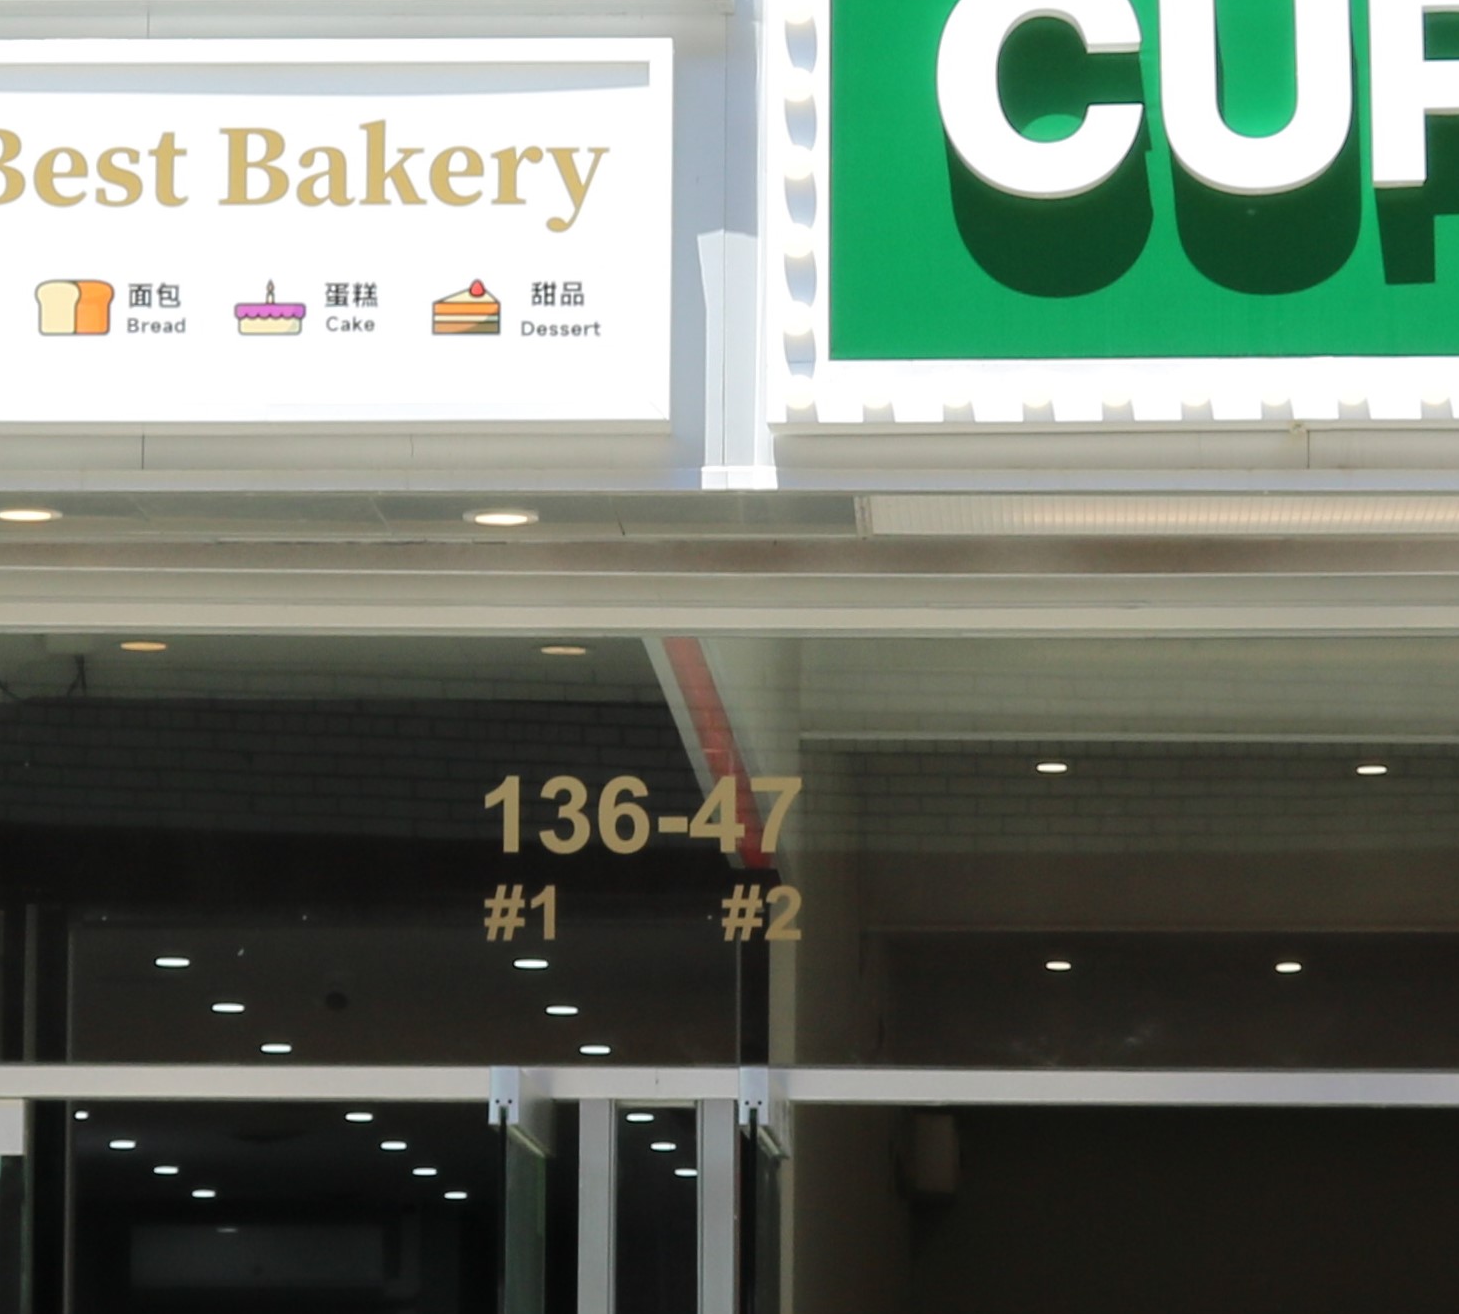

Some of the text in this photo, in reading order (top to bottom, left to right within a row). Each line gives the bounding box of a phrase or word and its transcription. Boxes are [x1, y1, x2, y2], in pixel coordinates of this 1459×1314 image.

[217, 119, 610, 233] Bakery
[127, 281, 181, 309] 面包
[324, 281, 379, 309] 蛋糕
[530, 280, 585, 309] 甜品
[126, 316, 187, 335] Bread
[325, 314, 376, 334] Cake
[520, 318, 601, 339] Dessert
[484, 775, 803, 854] 136-47
[484, 884, 803, 941] #1 #2
